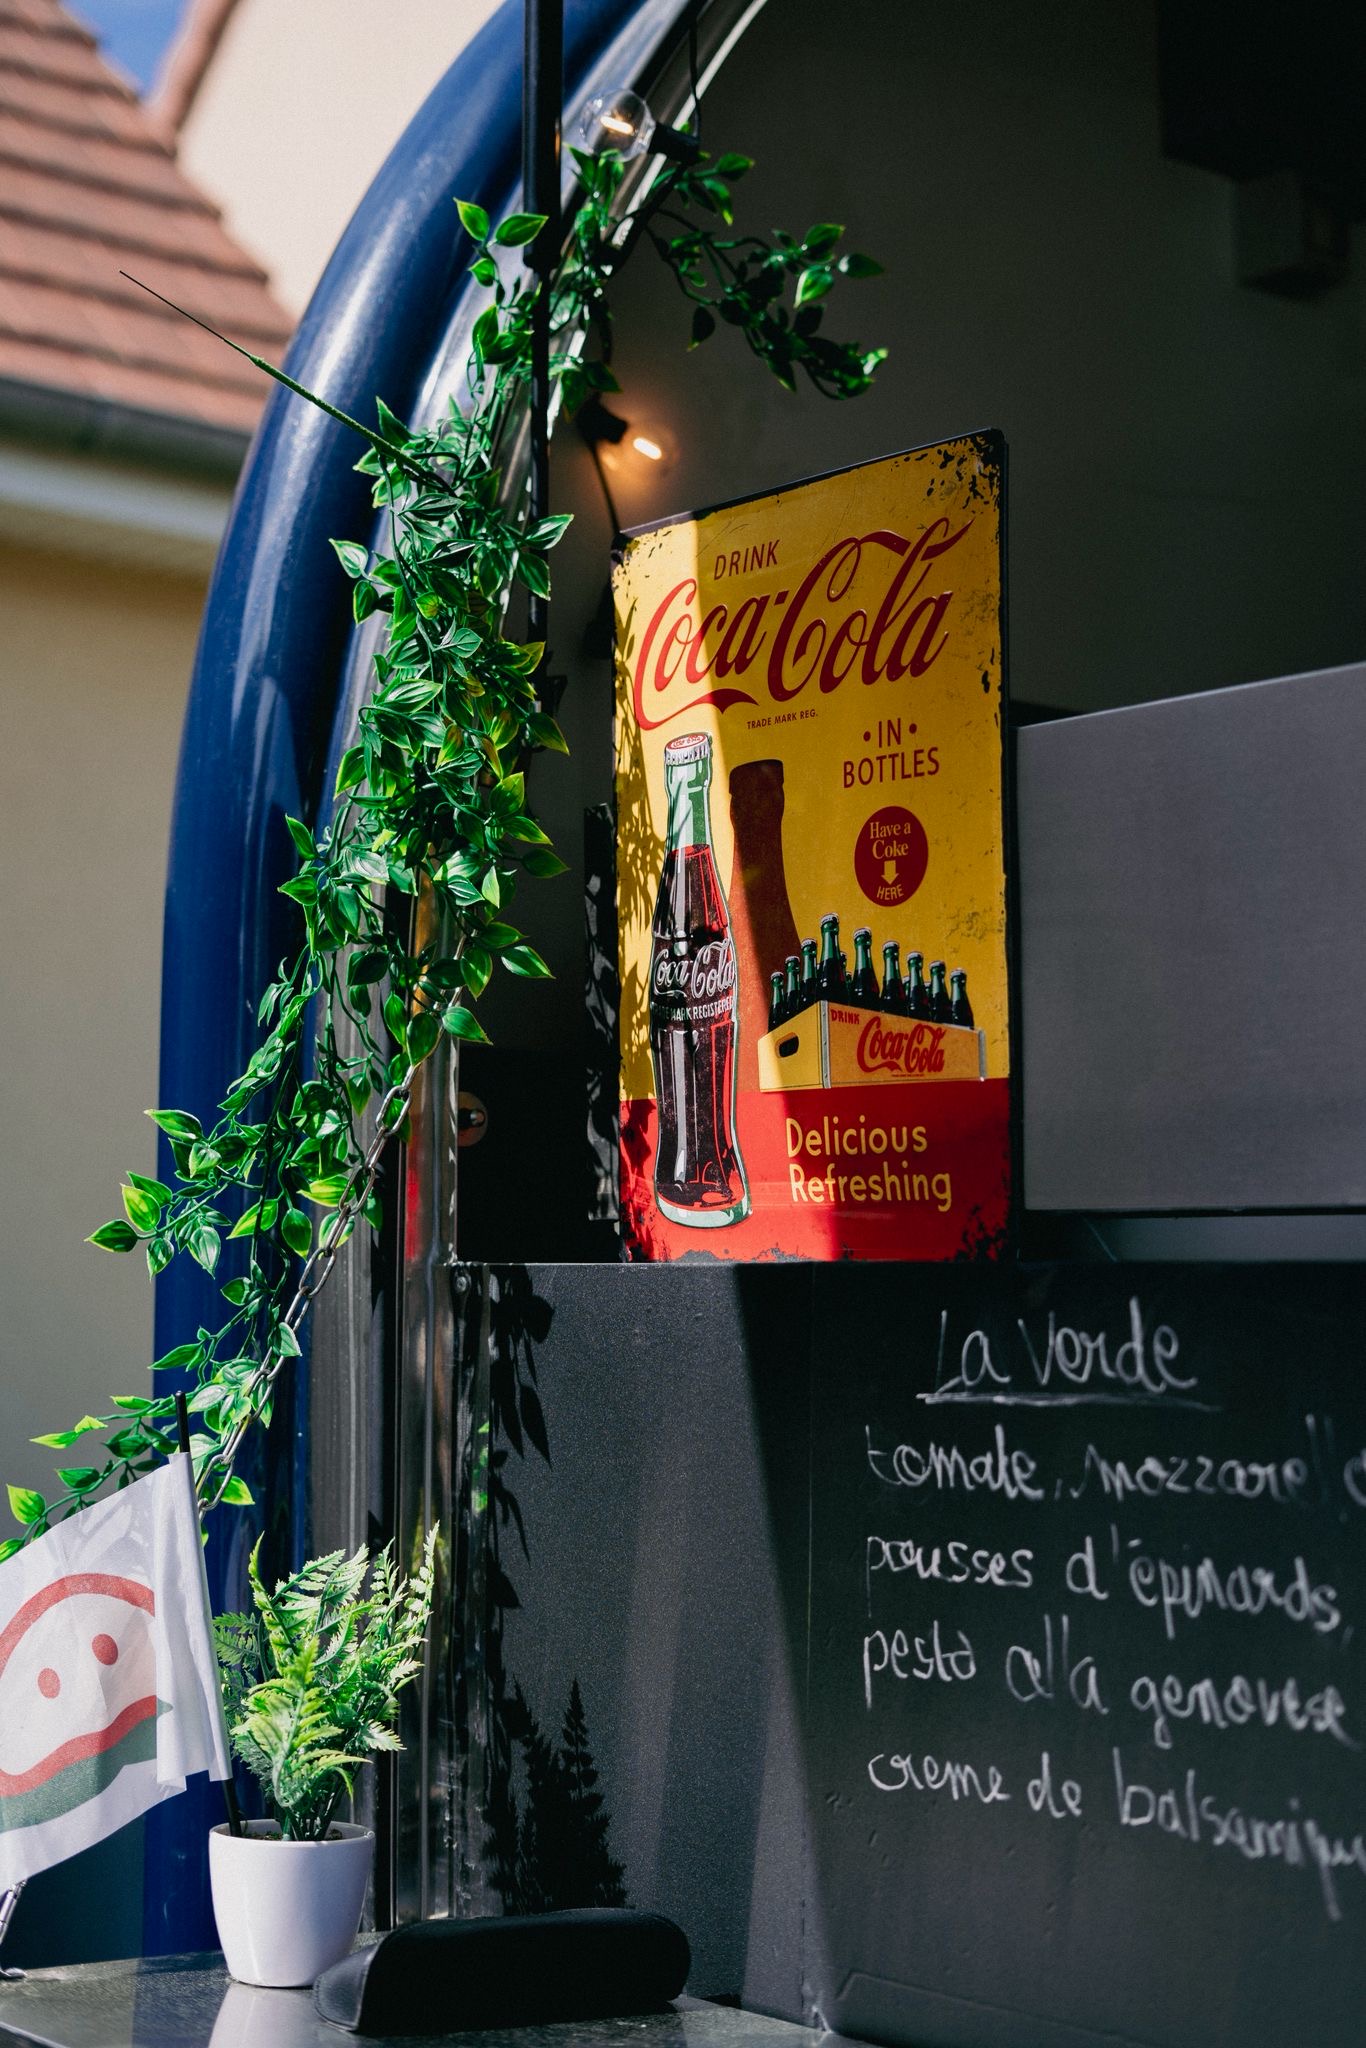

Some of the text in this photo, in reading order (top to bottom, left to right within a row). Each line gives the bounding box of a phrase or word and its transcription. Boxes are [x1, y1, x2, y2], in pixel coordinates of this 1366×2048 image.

[714, 540, 780, 581] DRINK
[633, 517, 975, 731] Coca-Cola
[747, 708, 819, 730] TRADE MARK REG.
[878, 717, 902, 748] IN
[843, 747, 940, 788] BOTTLES
[870, 822, 911, 840] Have a
[872, 840, 909, 860] Coke
[876, 884, 904, 900] HERE
[830, 1009, 860, 1024] DRINK
[786, 1115, 927, 1158] Delicious
[790, 1161, 952, 1213] Refreshing
[934, 1310, 1011, 1395] La
[866, 1536, 1034, 1618] pousses
[863, 1620, 977, 1712] pesto
[1006, 1614, 1109, 1714] alla
[1027, 1752, 1083, 1818] de
